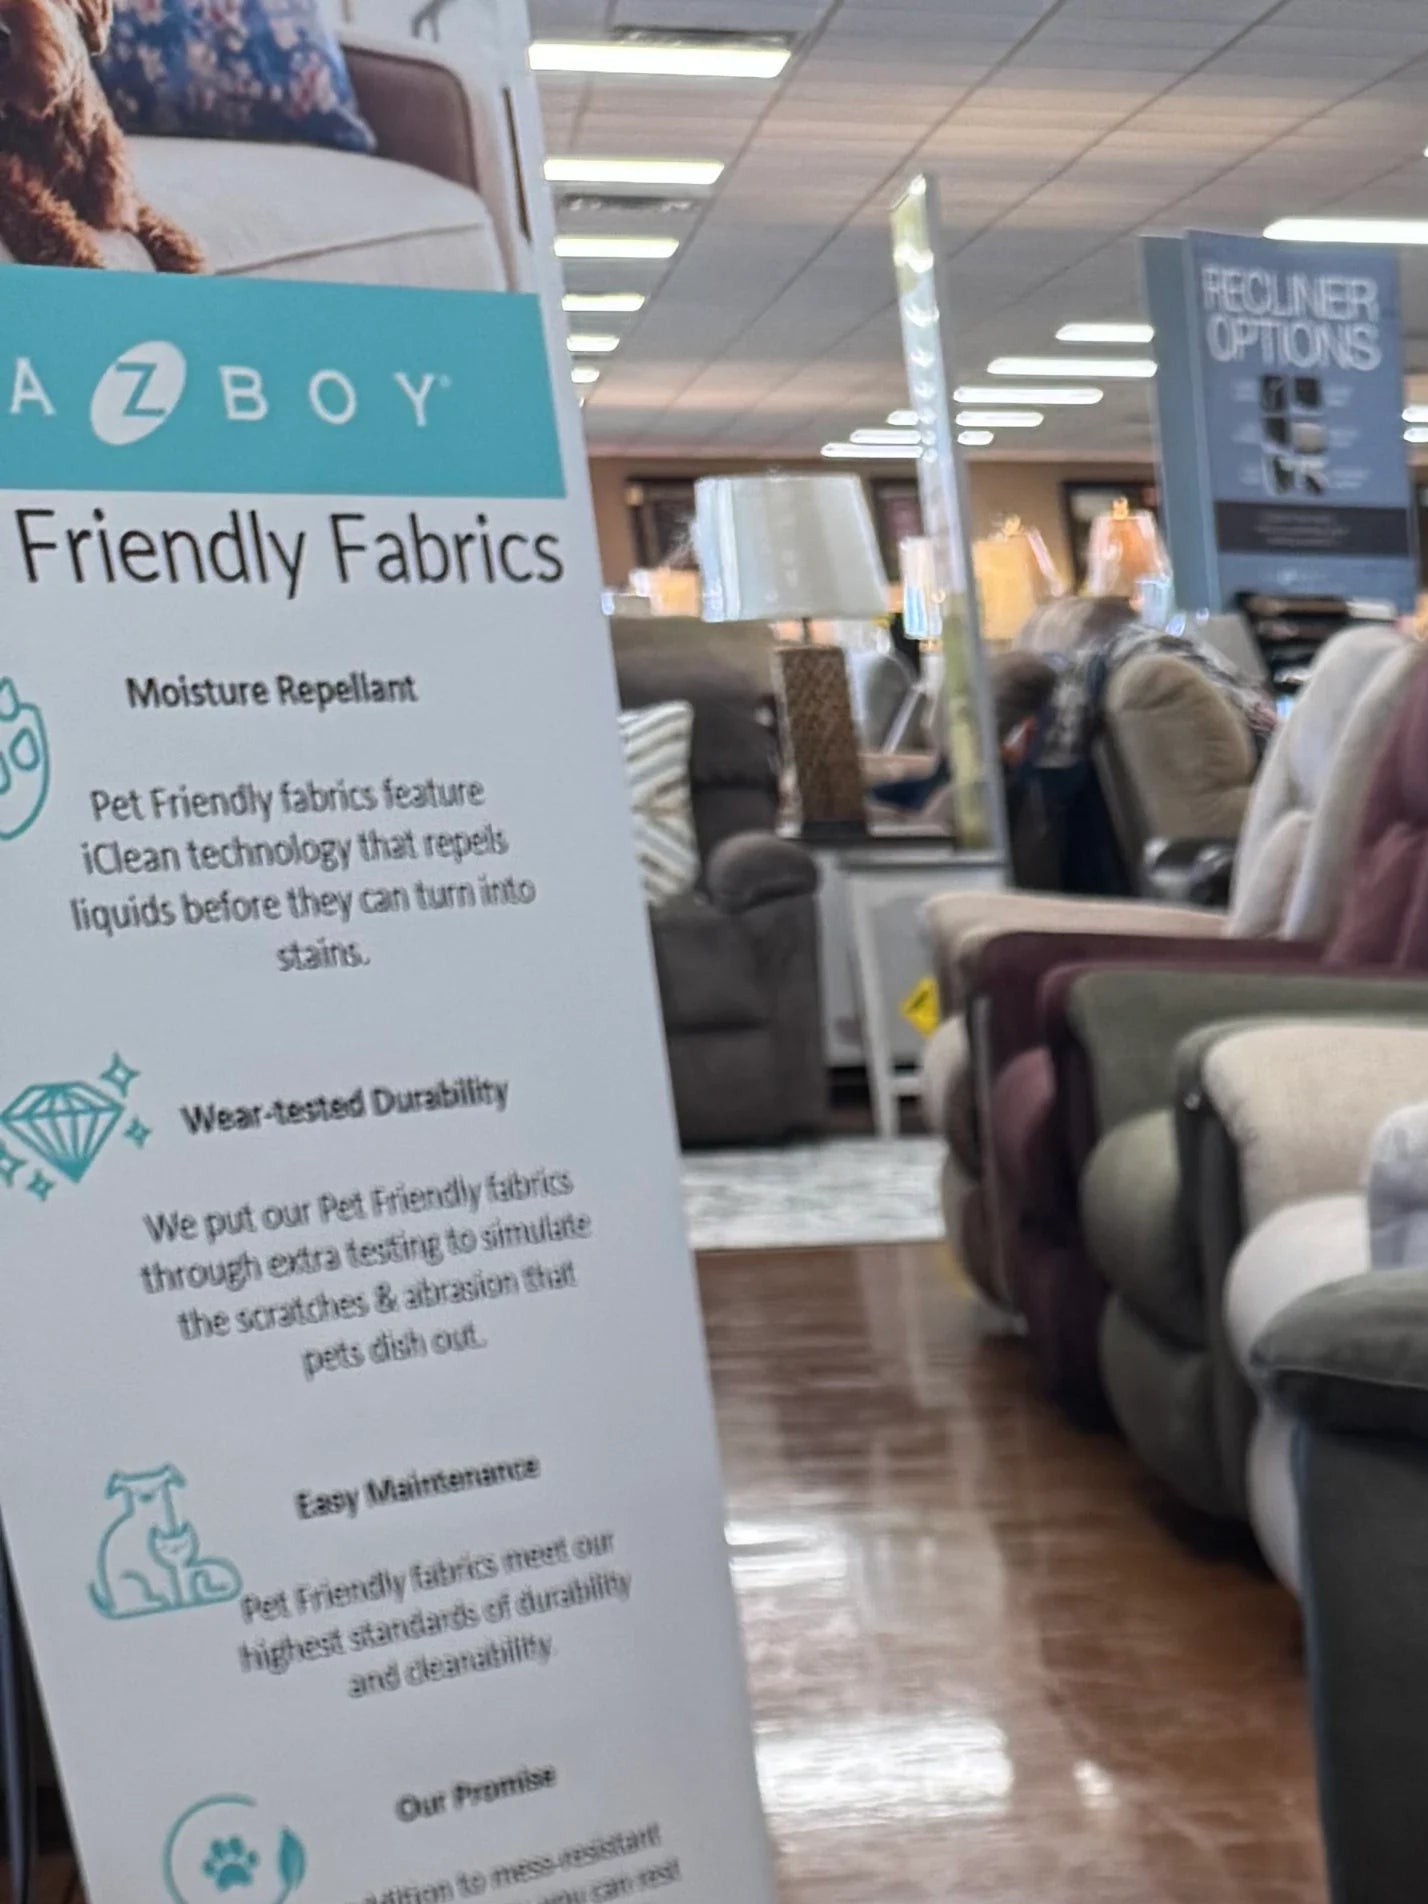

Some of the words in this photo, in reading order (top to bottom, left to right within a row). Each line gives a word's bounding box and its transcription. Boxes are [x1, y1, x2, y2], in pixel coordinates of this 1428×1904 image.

[1202, 265, 1381, 324] RECLINER
[1207, 316, 1383, 372] OPTIONS
[14, 508, 306, 600] Friendly
[329, 513, 565, 584] Fabrics
[125, 676, 269, 709] Moisture
[275, 672, 418, 713] Repellant
[89, 789, 146, 822] Pet
[151, 782, 273, 823] Friendly
[279, 778, 378, 815] fabrics
[382, 776, 485, 810] feature
[80, 841, 181, 876] iClean
[187, 833, 353, 872] technology
[357, 829, 419, 861] that
[423, 824, 510, 864] repels
[70, 897, 177, 938] liquids
[181, 890, 280, 925] before
[286, 885, 353, 924] they
[358, 884, 410, 914] can
[414, 880, 476, 911] turn
[478, 873, 537, 907] into
[275, 937, 371, 972] stains.
[178, 1087, 367, 1135] Wear-tested
[370, 1076, 509, 1117] Durability
[141, 1211, 198, 1244] We
[202, 1205, 257, 1244] put
[260, 1200, 312, 1232] our
[317, 1192, 369, 1225] Pet
[370, 1175, 484, 1216] Friendly
[485, 1167, 576, 1203] fabrics
[140, 1251, 262, 1295] through
[266, 1245, 342, 1279] extra
[344, 1230, 445, 1268] testing
[446, 1225, 478, 1256] to
[480, 1211, 593, 1252] simulate
[176, 1307, 232, 1341] the
[235, 1290, 370, 1336] scratches
[373, 1280, 398, 1313] &
[403, 1269, 519, 1311] abrasion
[521, 1259, 578, 1292] that
[301, 1342, 366, 1381] pets
[368, 1328, 428, 1364] dish
[294, 1487, 361, 1520] Easy
[364, 1454, 542, 1508] Maintenance
[240, 1591, 292, 1624] Pet
[294, 1567, 408, 1616] Friendly
[409, 1552, 500, 1592] fabrics
[501, 1536, 569, 1574] meet
[571, 1529, 615, 1560] our
[238, 1629, 344, 1676] highest
[347, 1601, 482, 1652] standards
[483, 1593, 513, 1624] of
[515, 1569, 632, 1617] durability
[348, 1660, 401, 1699] and
[394, 1793, 448, 1823] Our
[452, 1764, 558, 1812] Promise
[455, 1869, 487, 1898] to
[589, 1874, 635, 1904] can
[636, 1857, 682, 1890] rest
